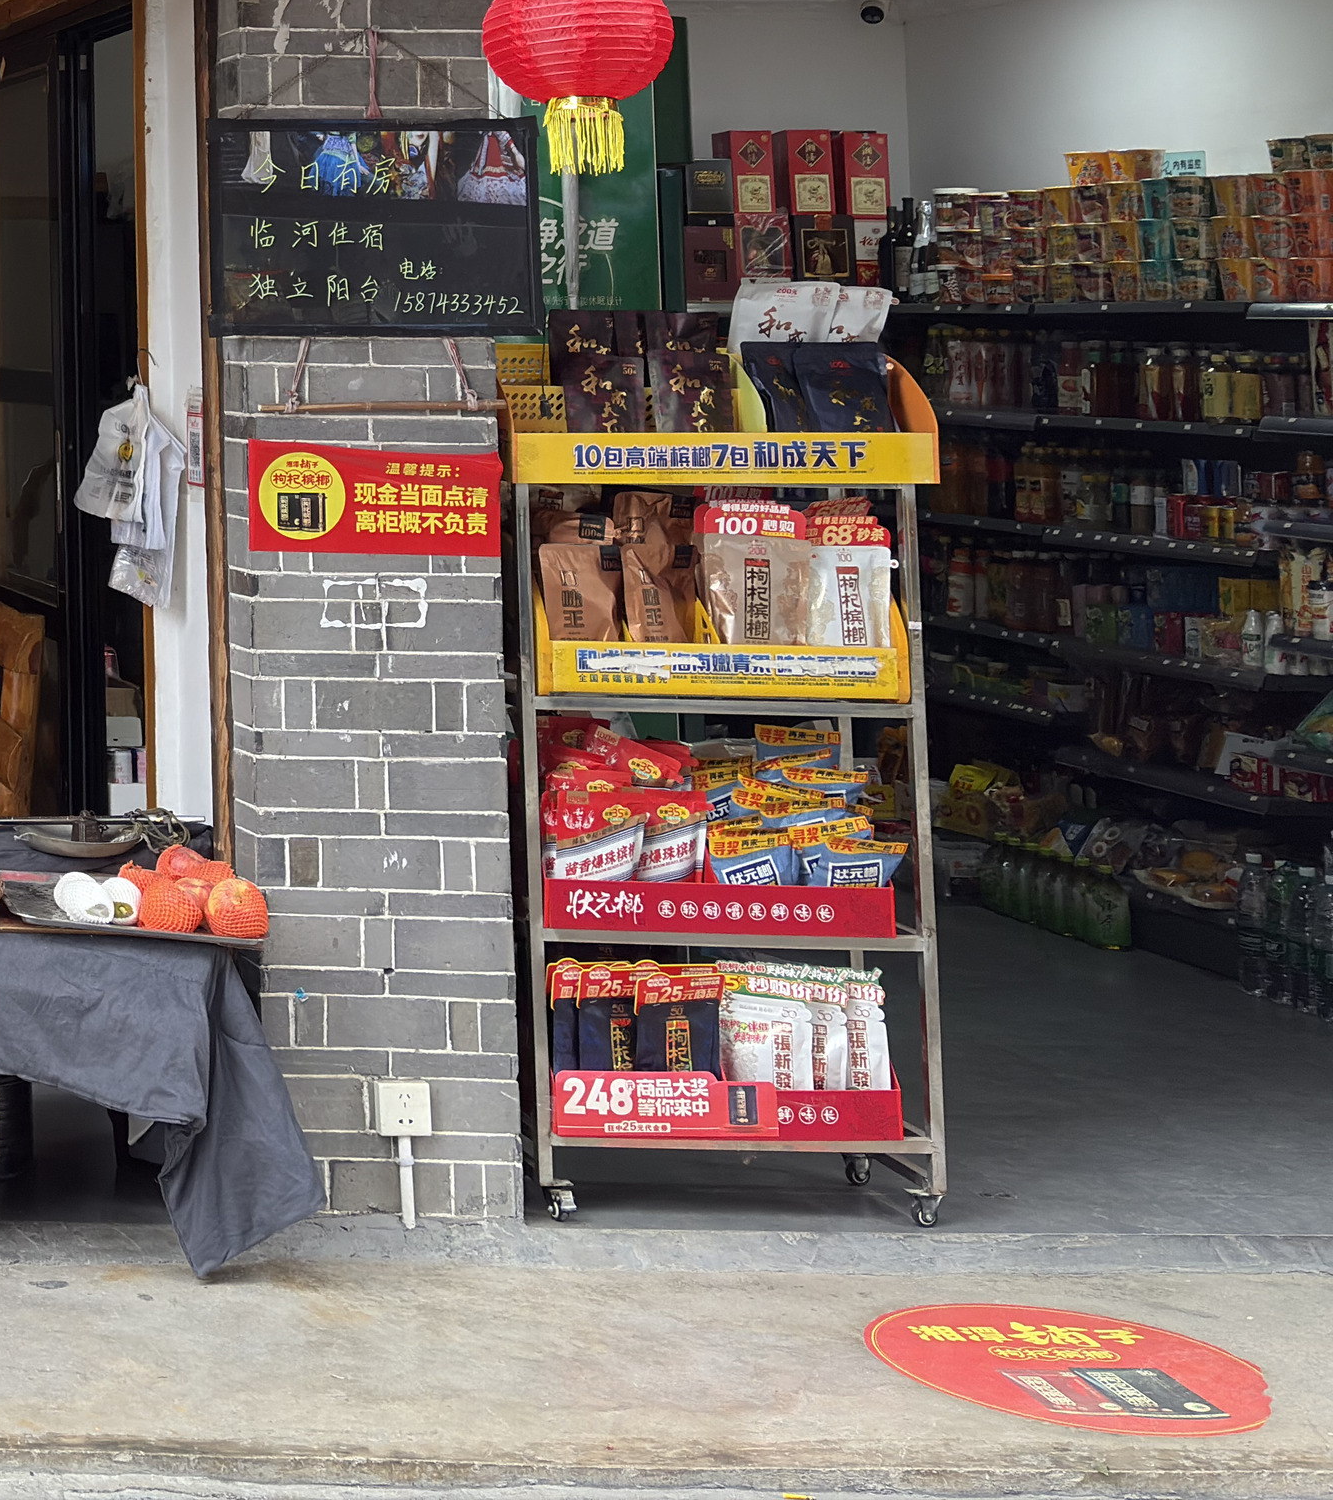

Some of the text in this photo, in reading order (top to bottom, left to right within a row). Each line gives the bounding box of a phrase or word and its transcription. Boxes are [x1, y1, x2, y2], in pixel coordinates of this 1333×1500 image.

[253, 155, 397, 197] 今日有房
[249, 217, 384, 251] 临河住宿
[248, 270, 381, 307] 独立阳台
[573, 440, 867, 469] 10包高端槟榔7包和成天下
[272, 471, 331, 486] 枸杞槟榔
[386, 462, 461, 478] 温馨提示:
[354, 483, 489, 508] 现金当面点清
[355, 510, 488, 536] 离柜概不负责
[715, 518, 757, 535] 100
[856, 528, 885, 542] 秒杀
[747, 568, 769, 638] 枸杞槟榔
[840, 576, 865, 644] 枸杞槟榔
[713, 837, 775, 856] 寻奖 再来一包
[774, 1034, 792, 1089] 張新發
[849, 1033, 870, 1088] 張新發
[636, 1078, 709, 1098] 商品大奖
[637, 1098, 710, 1117] 等你来中
